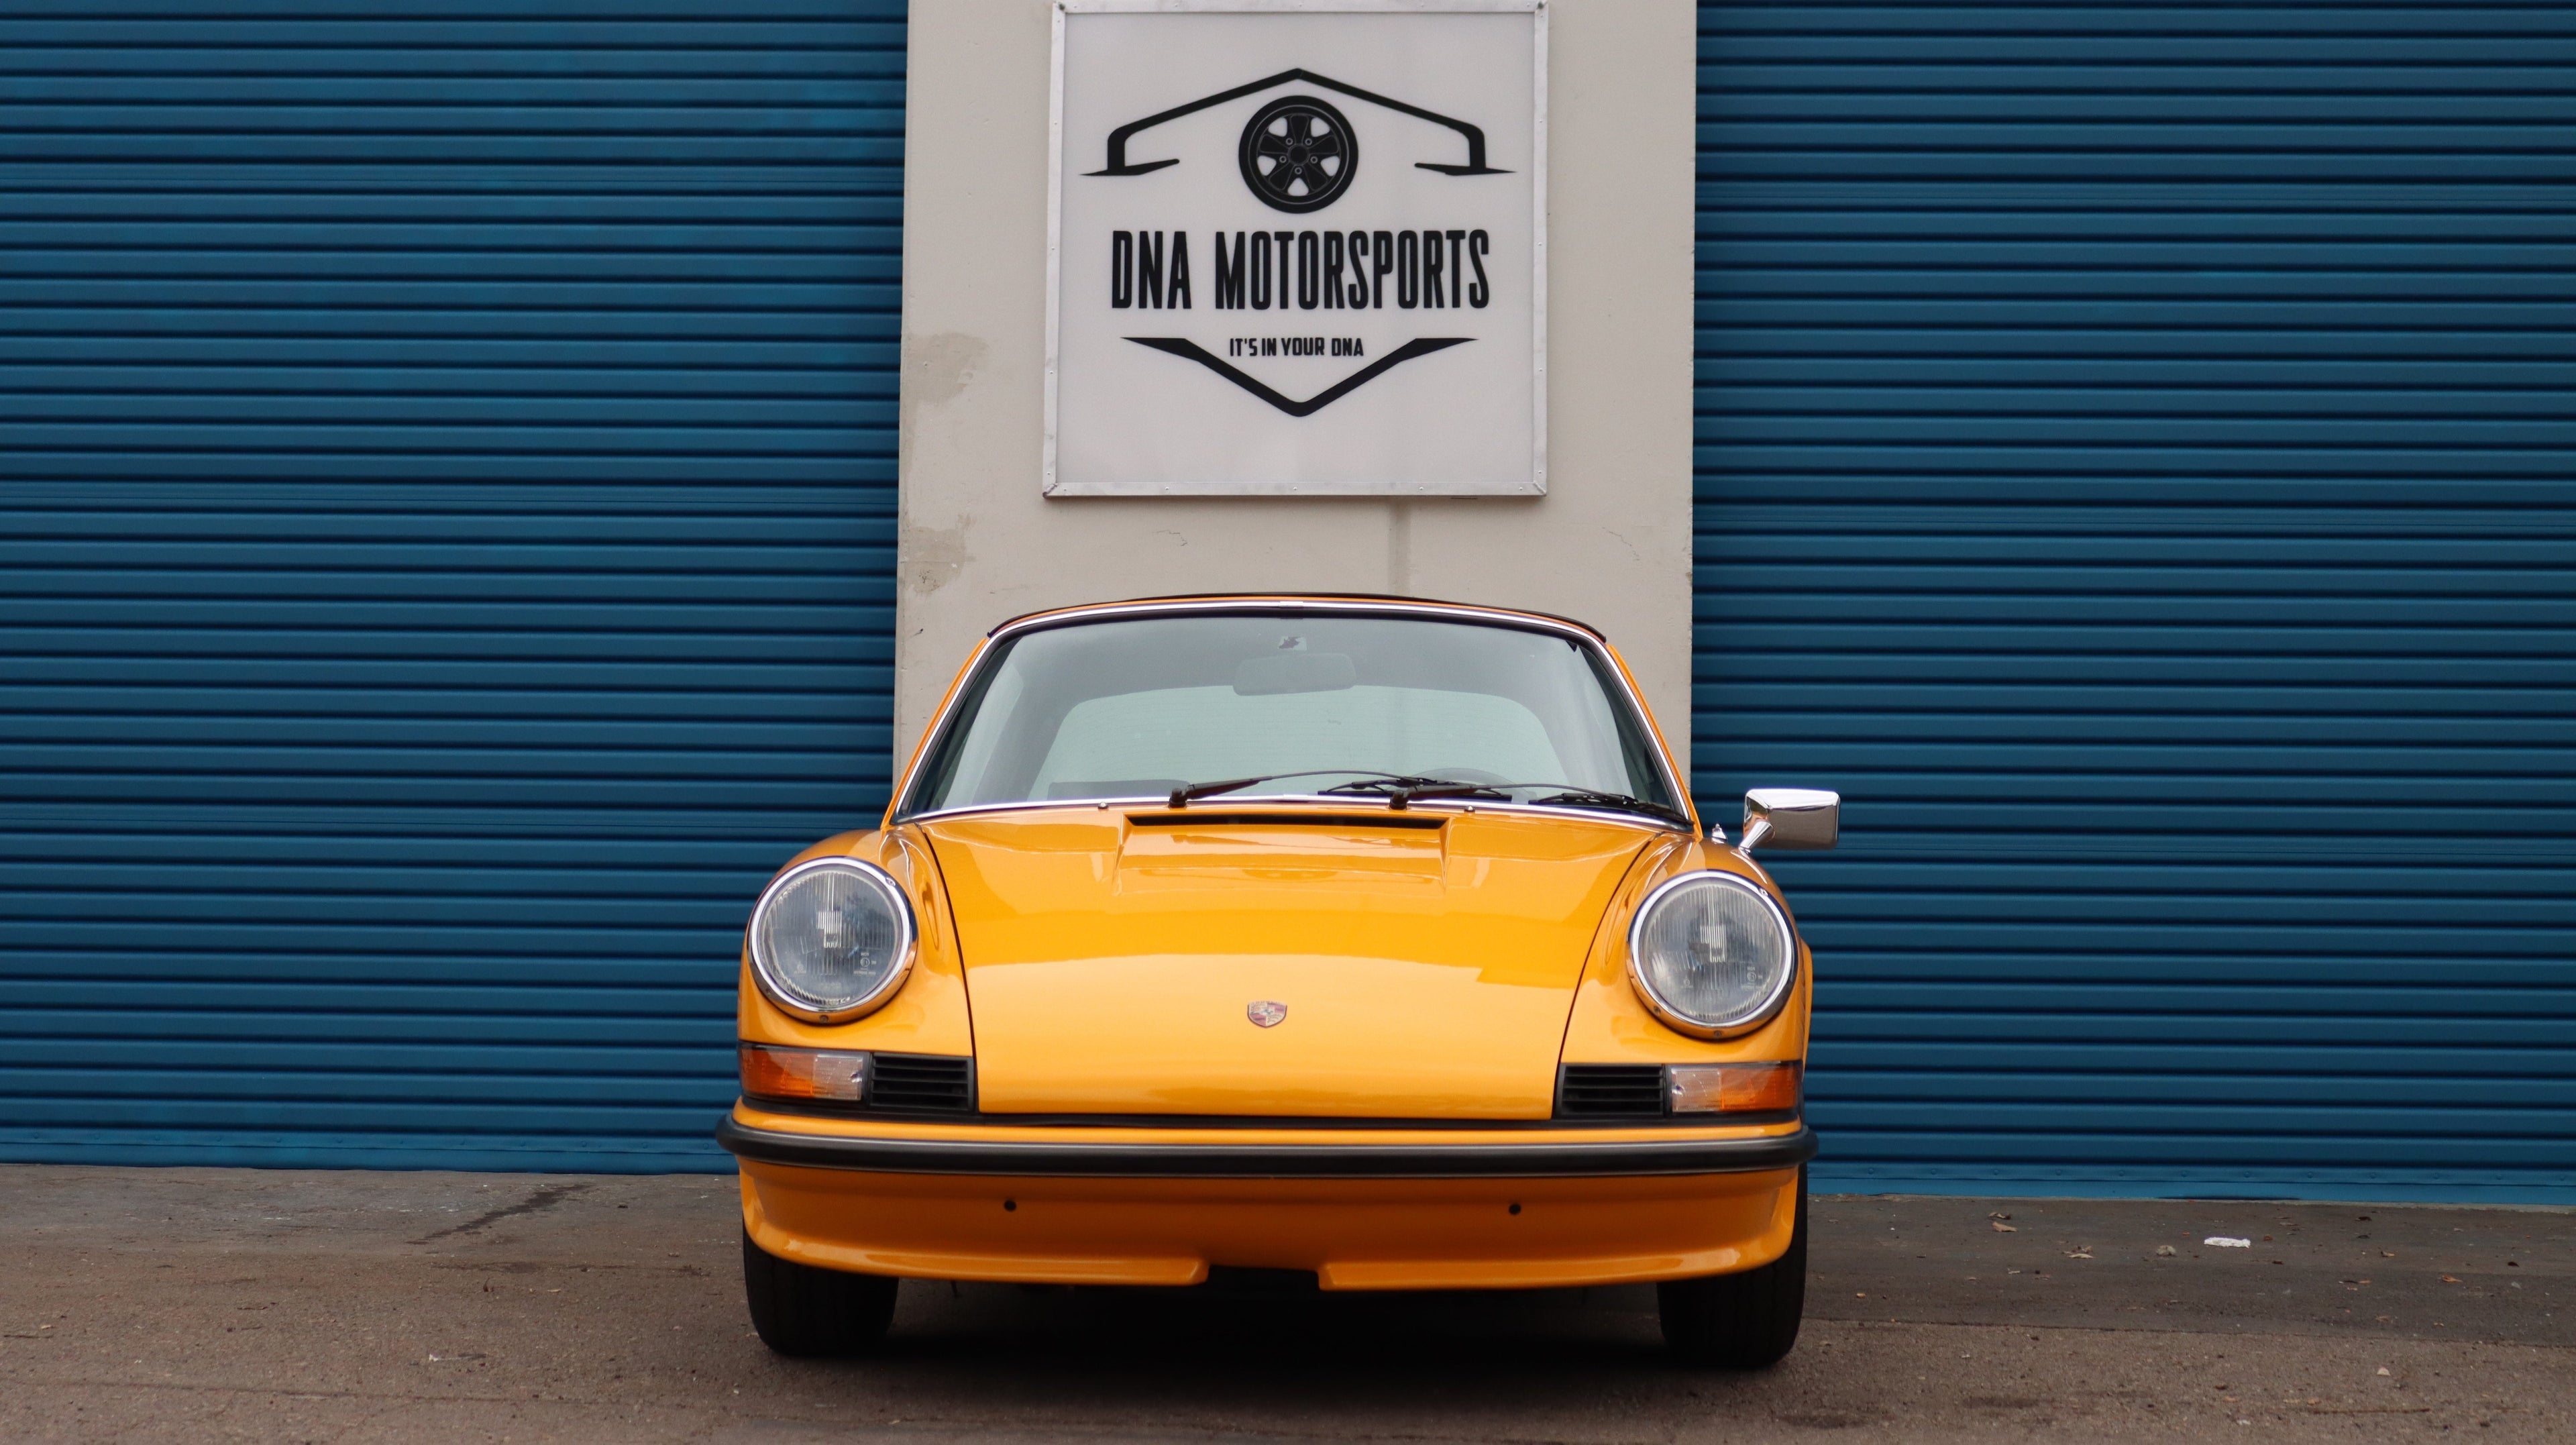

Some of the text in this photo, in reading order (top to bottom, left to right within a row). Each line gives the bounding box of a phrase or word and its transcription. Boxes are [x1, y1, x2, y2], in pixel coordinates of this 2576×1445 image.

[1112, 229, 1490, 311] DNA MOTORSPORTS
[1230, 337, 1364, 357] IT'S IN YOUR DNA
